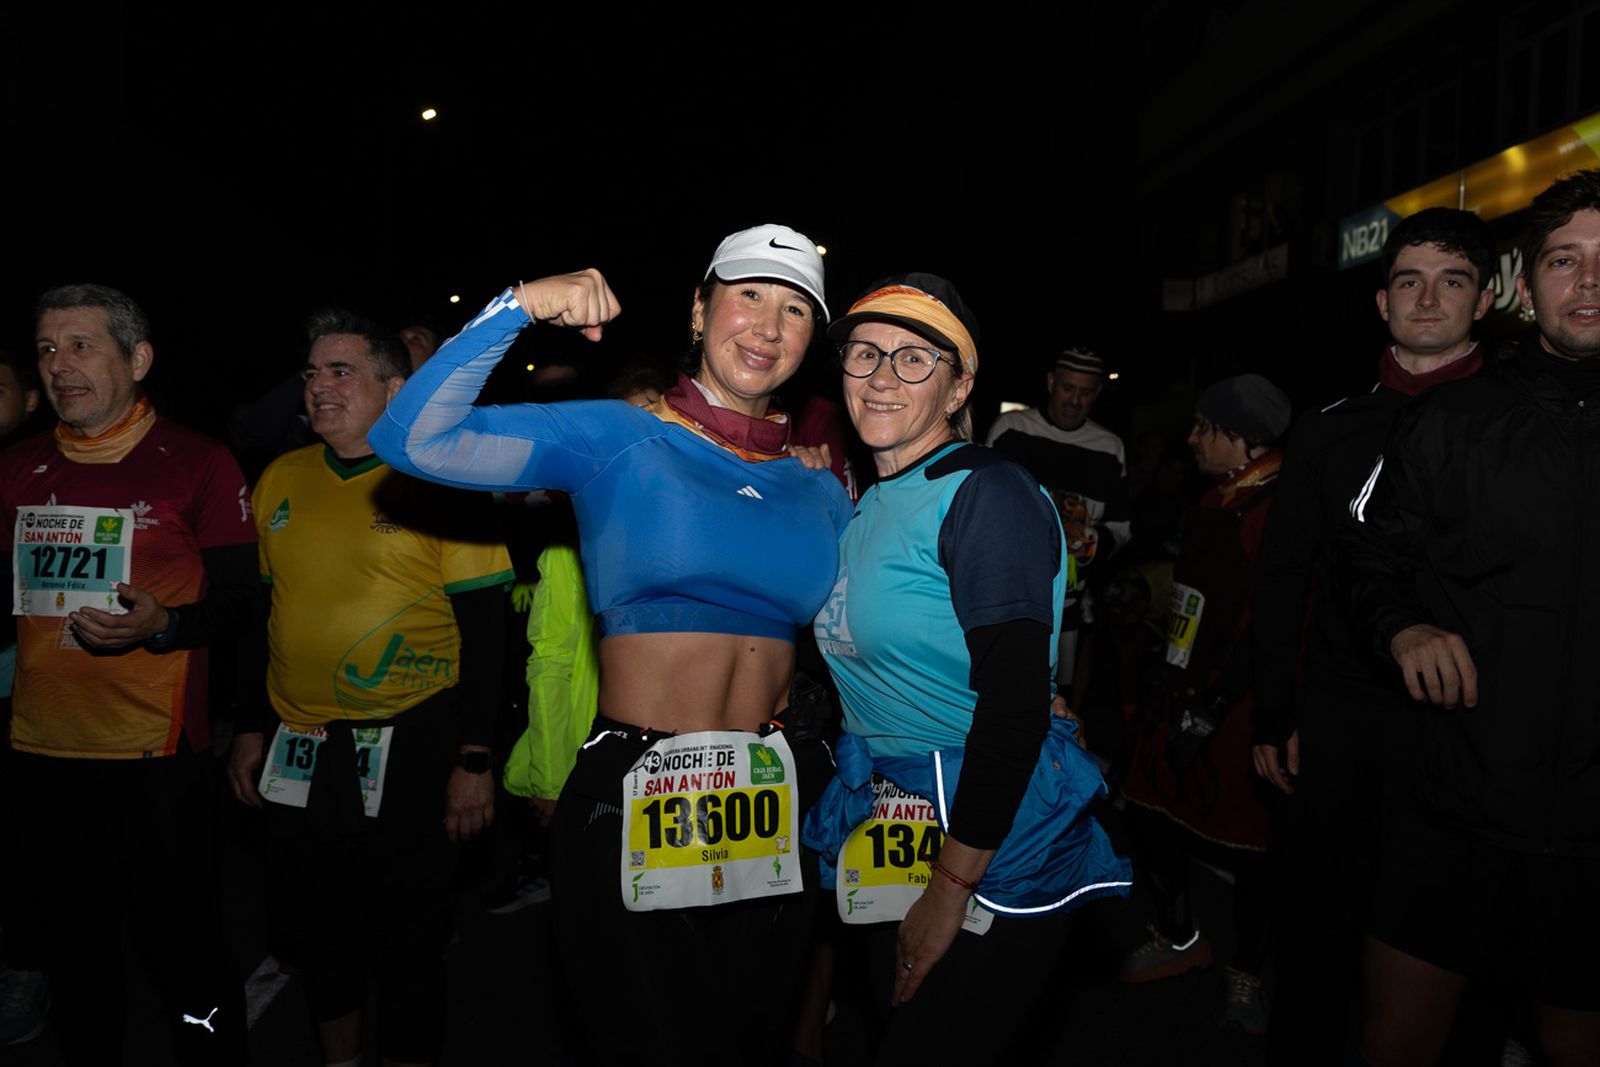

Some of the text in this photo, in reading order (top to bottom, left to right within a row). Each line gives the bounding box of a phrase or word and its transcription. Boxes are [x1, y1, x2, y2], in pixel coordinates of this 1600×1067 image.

[1342, 218, 1388, 262] NB21
[36, 518, 67, 529] NOCHE
[69, 519, 84, 530] DE
[24, 531, 44, 544] SAN
[45, 529, 82, 544] ANTÓN
[30, 546, 107, 580] 12721
[700, 744, 734, 752] INTRNACIONAL
[662, 750, 735, 772] NOCHE DE
[644, 767, 735, 797] SAN ANTÓN
[642, 789, 780, 850] 13600
[892, 804, 937, 821] ANTO
[702, 848, 729, 862] Silvia
[865, 823, 942, 869] 134
